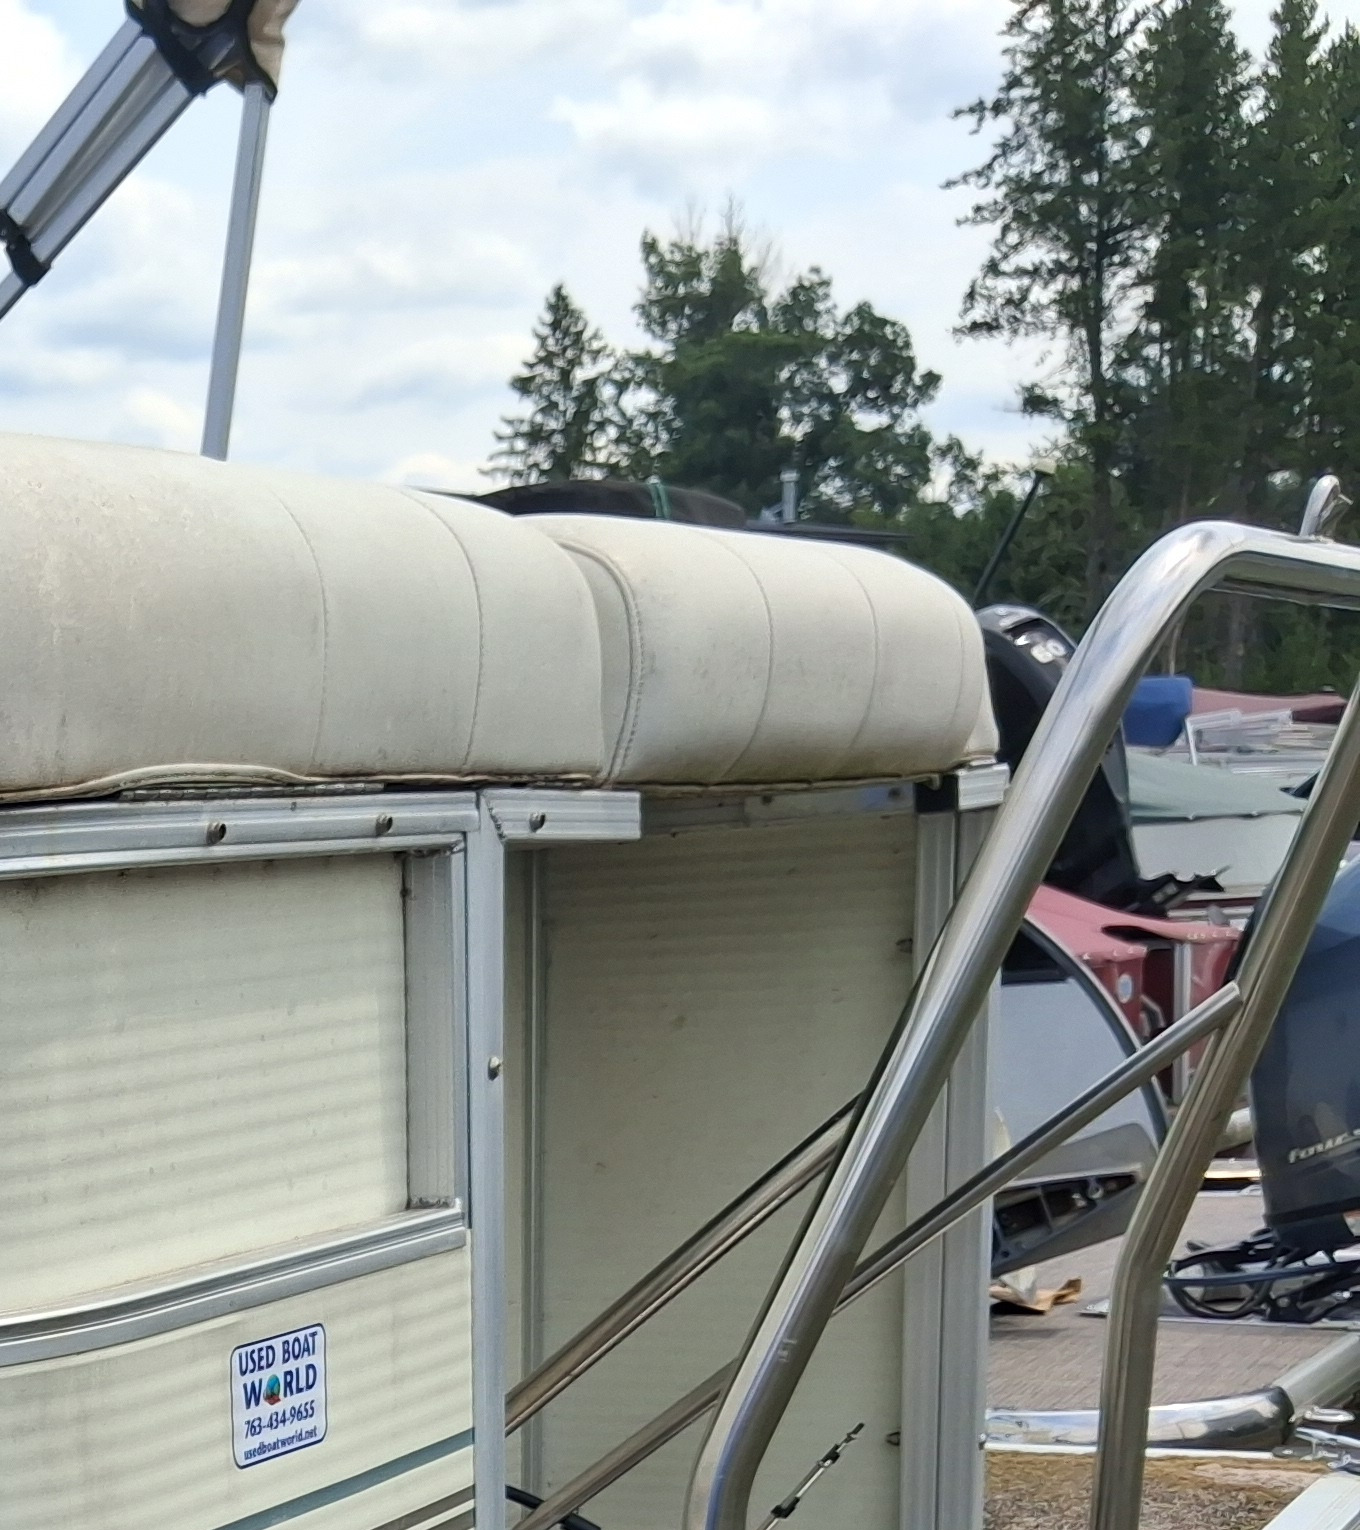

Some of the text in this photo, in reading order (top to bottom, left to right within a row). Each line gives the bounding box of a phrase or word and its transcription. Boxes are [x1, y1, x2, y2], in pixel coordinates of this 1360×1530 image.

[238, 1331, 318, 1376] USED BOAT
[245, 1400, 315, 1439] 763-434-9655
[244, 1425, 317, 1460] usedboatworld.net
